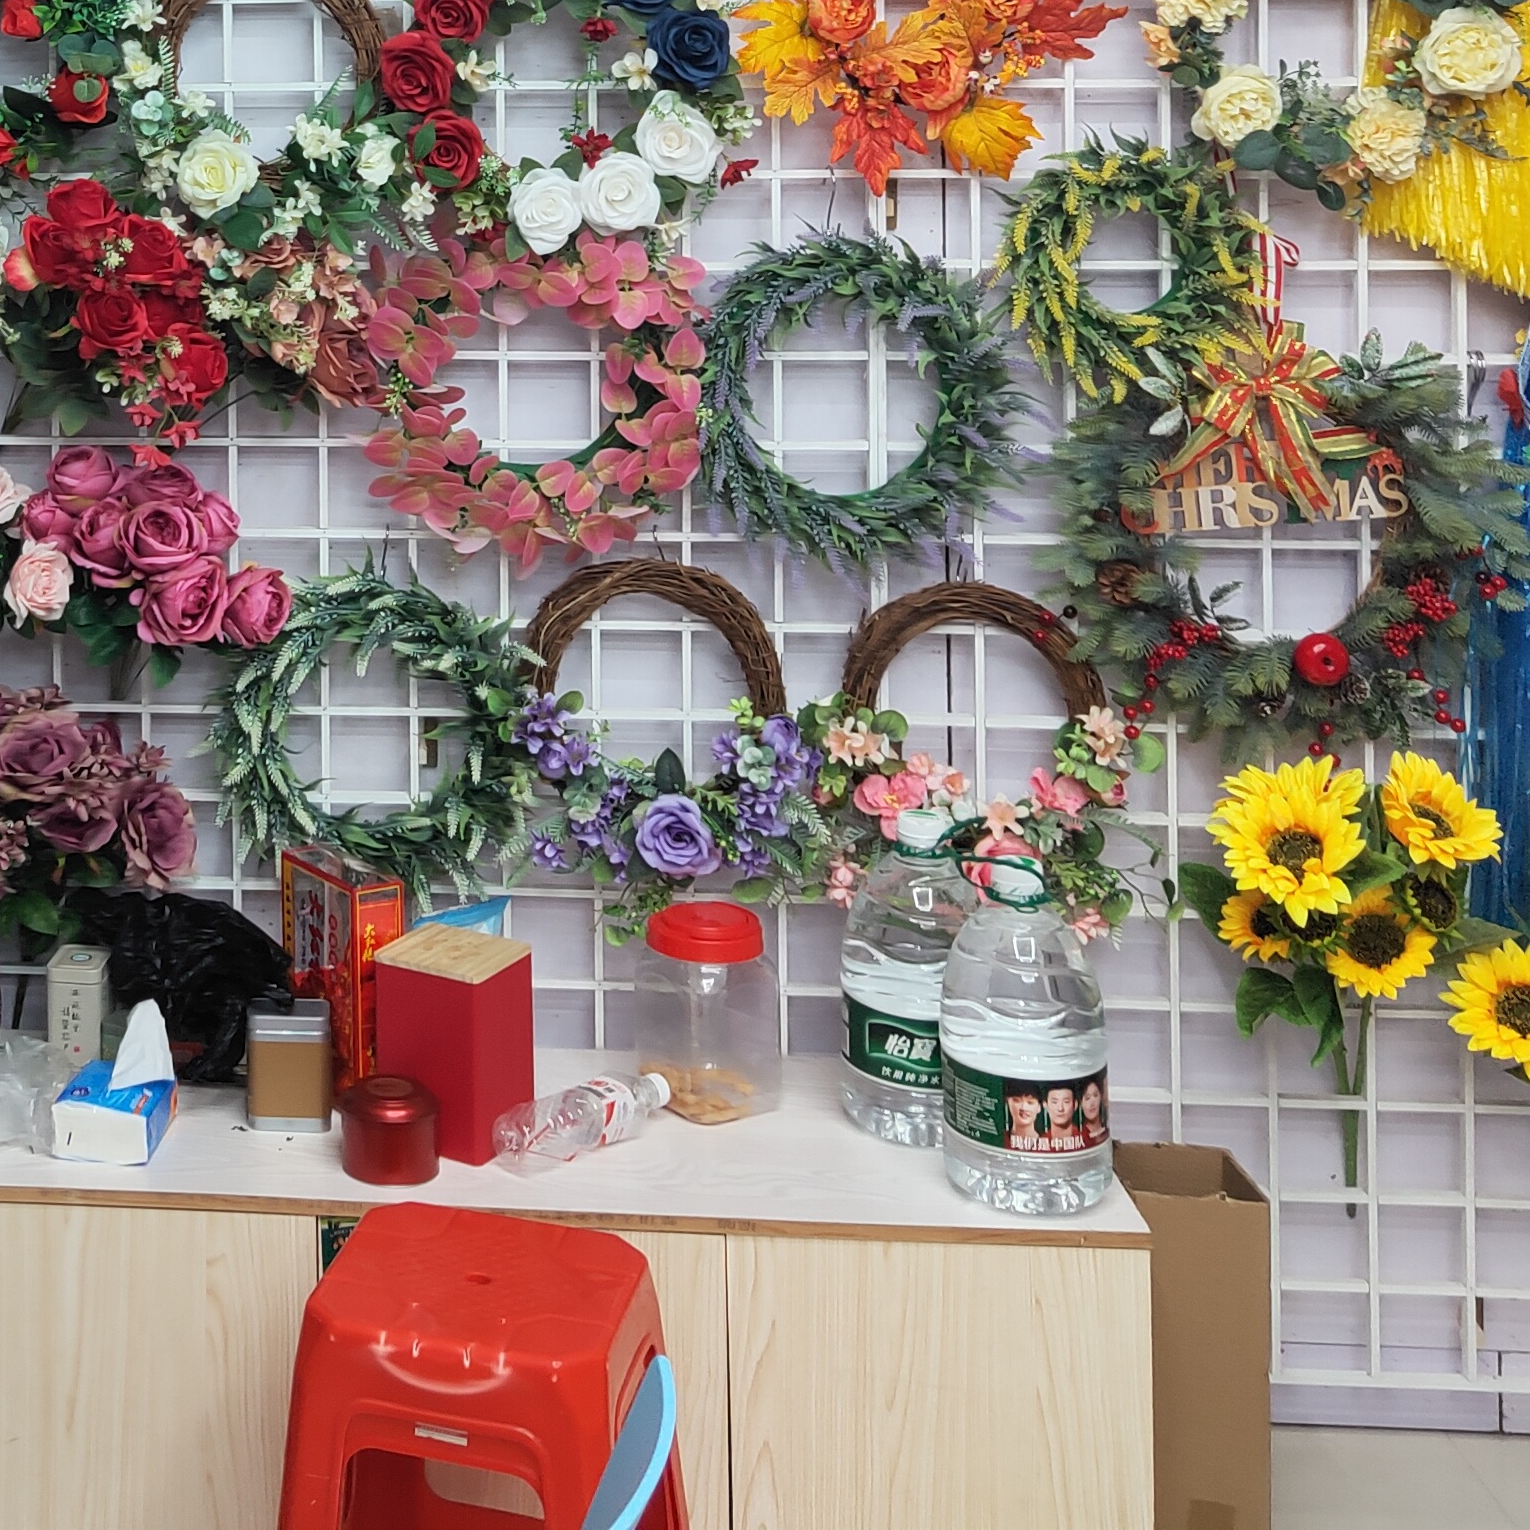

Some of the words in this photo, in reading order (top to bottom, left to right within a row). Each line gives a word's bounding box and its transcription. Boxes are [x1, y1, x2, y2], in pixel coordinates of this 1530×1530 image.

[881, 1065, 940, 1085] 饮用纯净水
[1010, 1134, 1086, 1152] 我们是中国队
